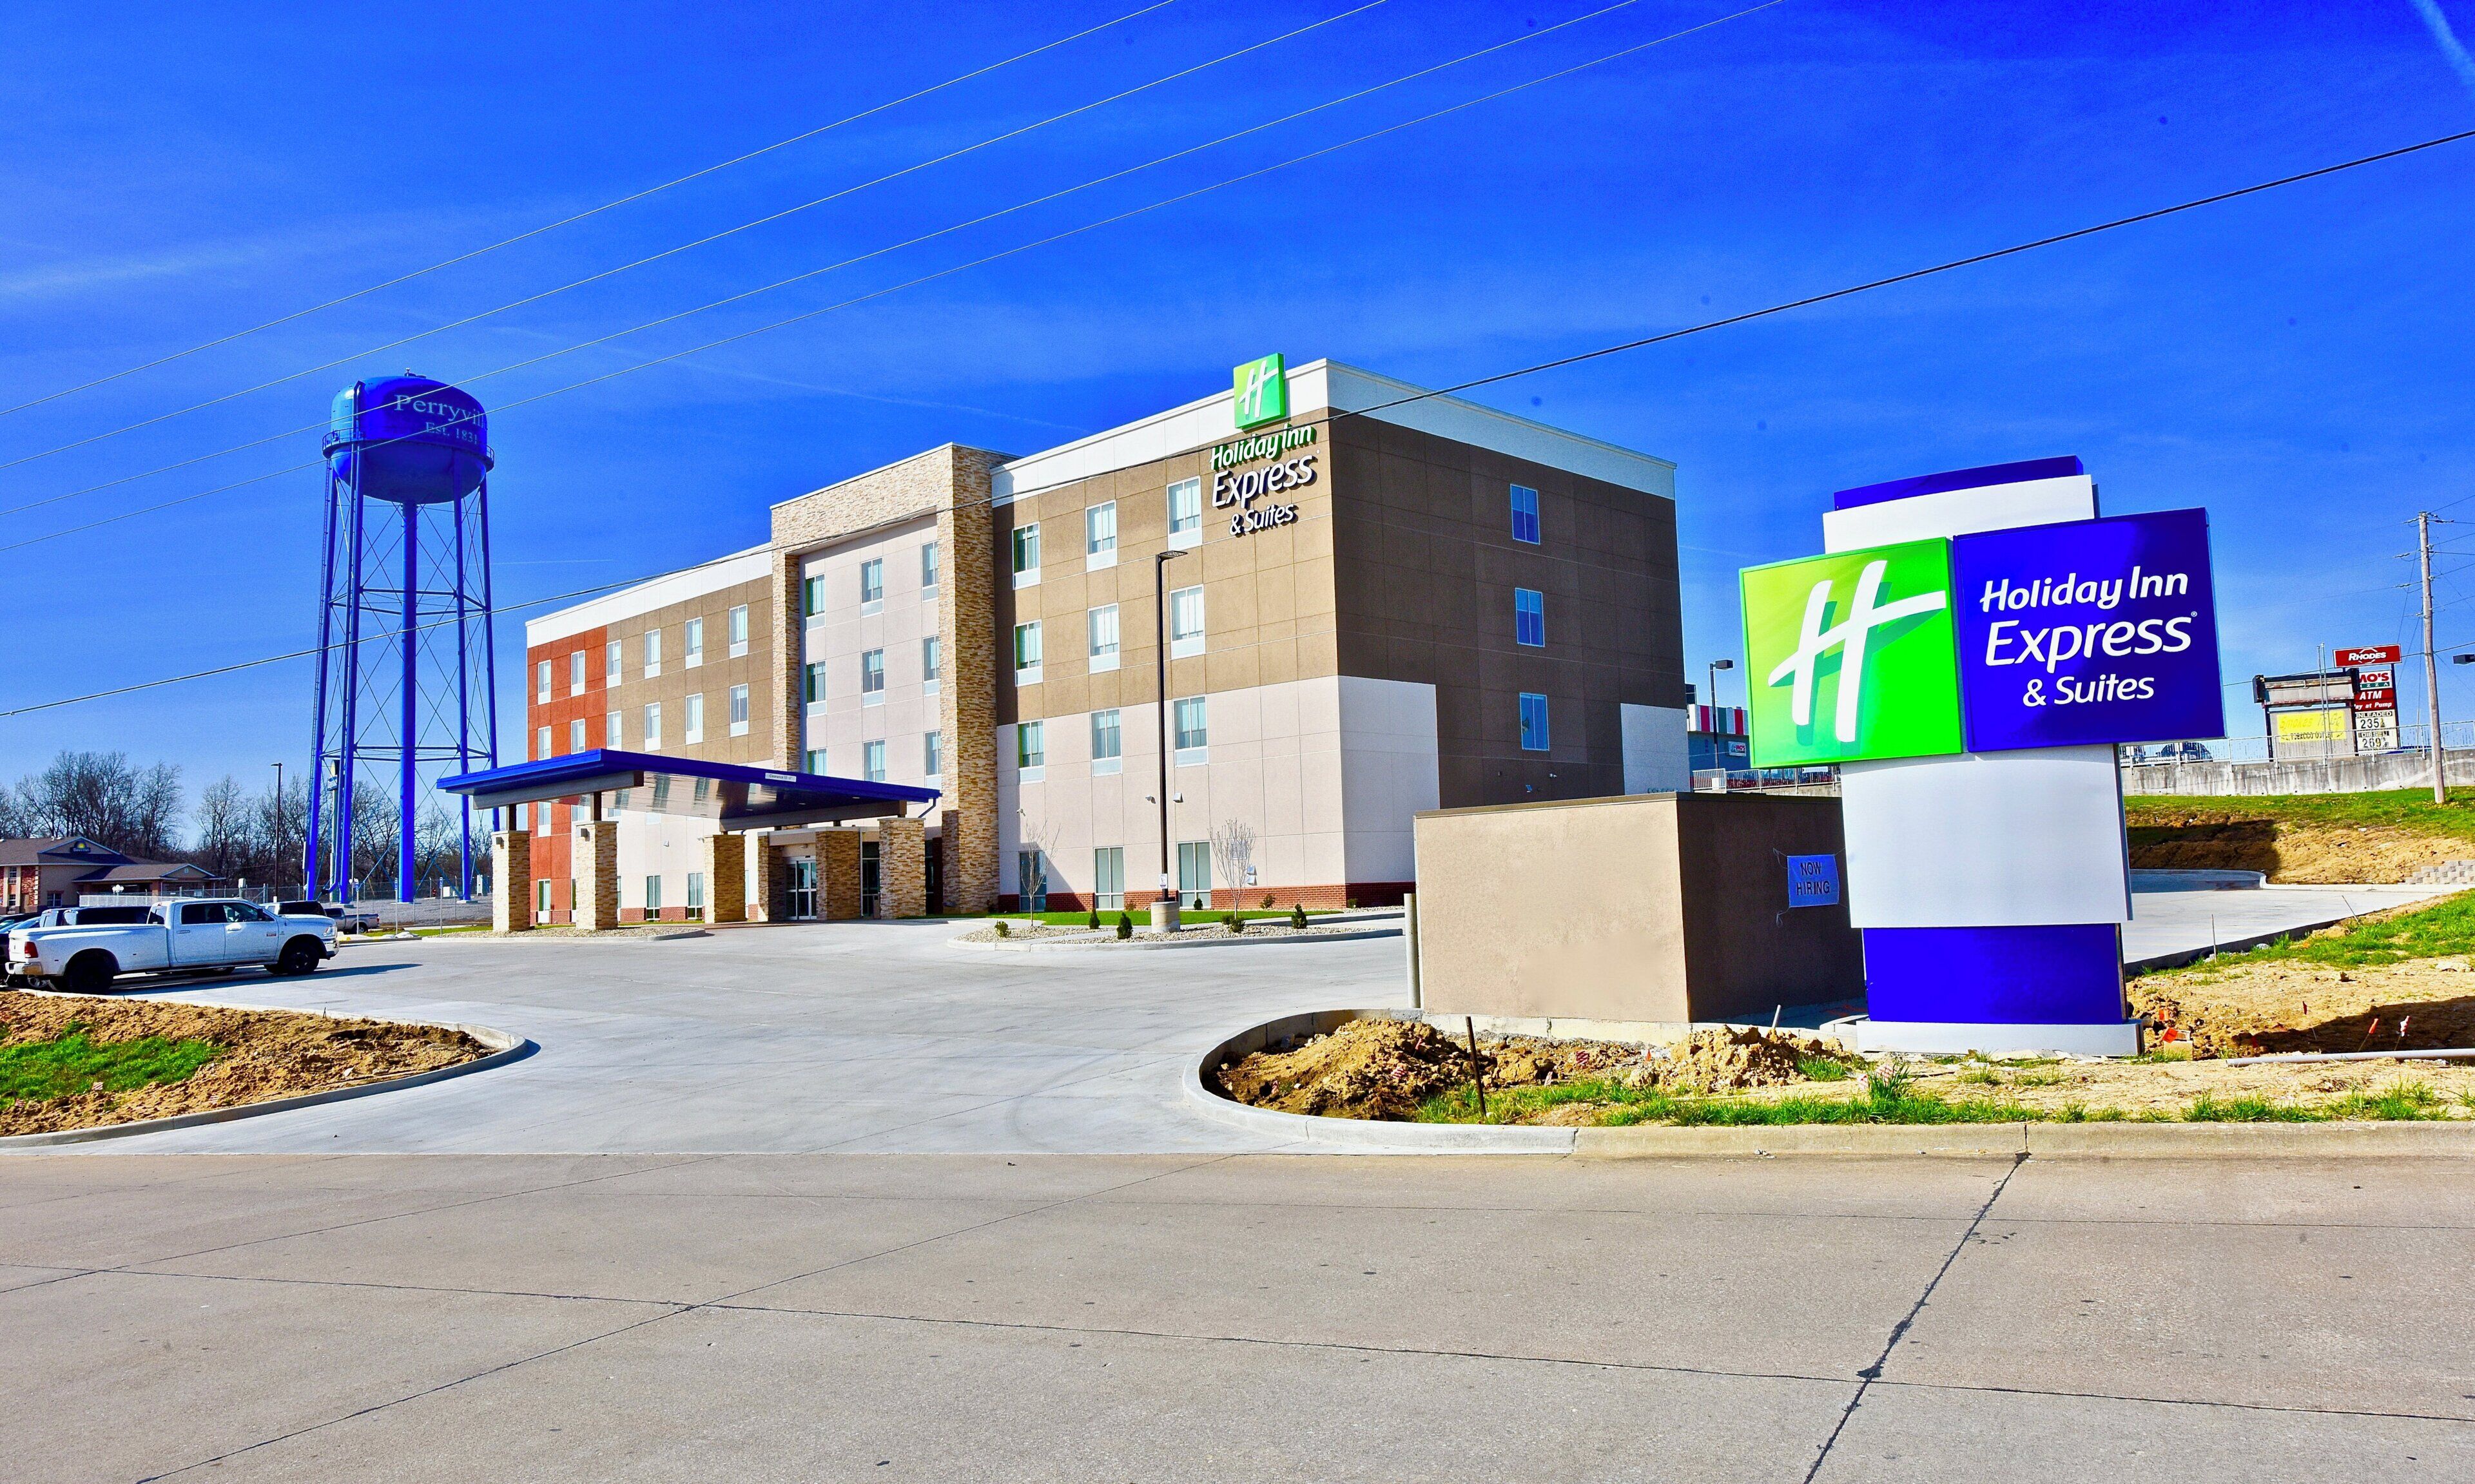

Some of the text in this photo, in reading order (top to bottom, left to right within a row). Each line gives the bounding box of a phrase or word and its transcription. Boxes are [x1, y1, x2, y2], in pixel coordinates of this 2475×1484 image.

[394, 394, 485, 429] Perryvill
[425, 421, 477, 445] Est. 1831
[1210, 423, 1312, 470] Holiday Inn
[1212, 455, 1313, 508] Express
[1229, 503, 1294, 535] & Suites
[1979, 566, 2188, 612] Holiday Inn
[1985, 617, 2192, 673] Express
[2348, 651, 2387, 661] RHODES
[2023, 673, 2155, 707] & Suites
[2360, 673, 2389, 683] MO'S
[2360, 691, 2382, 700] ATM
[2280, 717, 2313, 729] Smokes
[1800, 861, 1821, 875] NOW
[1796, 880, 1830, 895] HIRING
